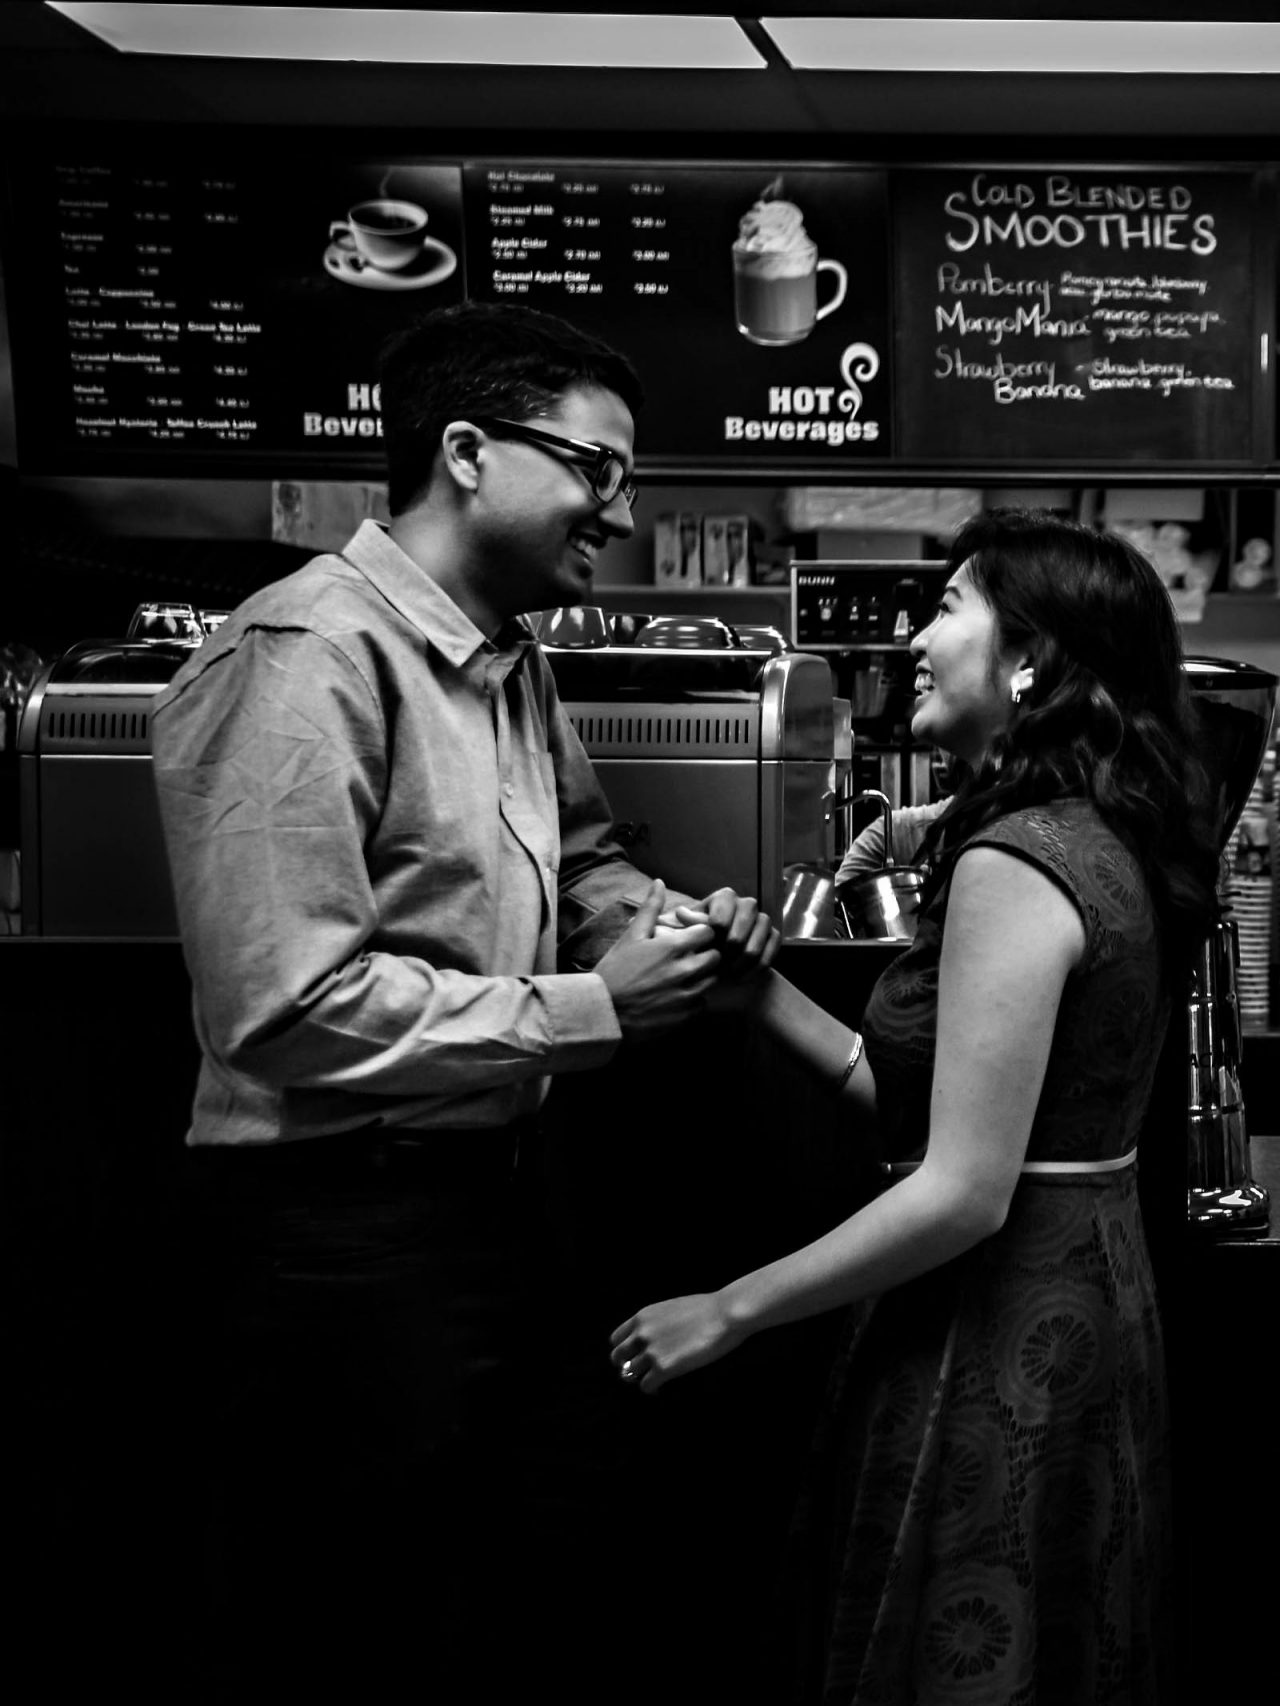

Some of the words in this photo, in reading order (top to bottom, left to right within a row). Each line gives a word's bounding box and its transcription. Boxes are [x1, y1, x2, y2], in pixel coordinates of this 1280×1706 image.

[971, 173, 1036, 210] COLD
[1045, 175, 1192, 213] BLENDED
[944, 191, 1218, 255] SMOOTHIES
[933, 345, 1056, 390] Strawberry
[768, 386, 835, 415] HOT
[724, 416, 879, 446] Beverages
